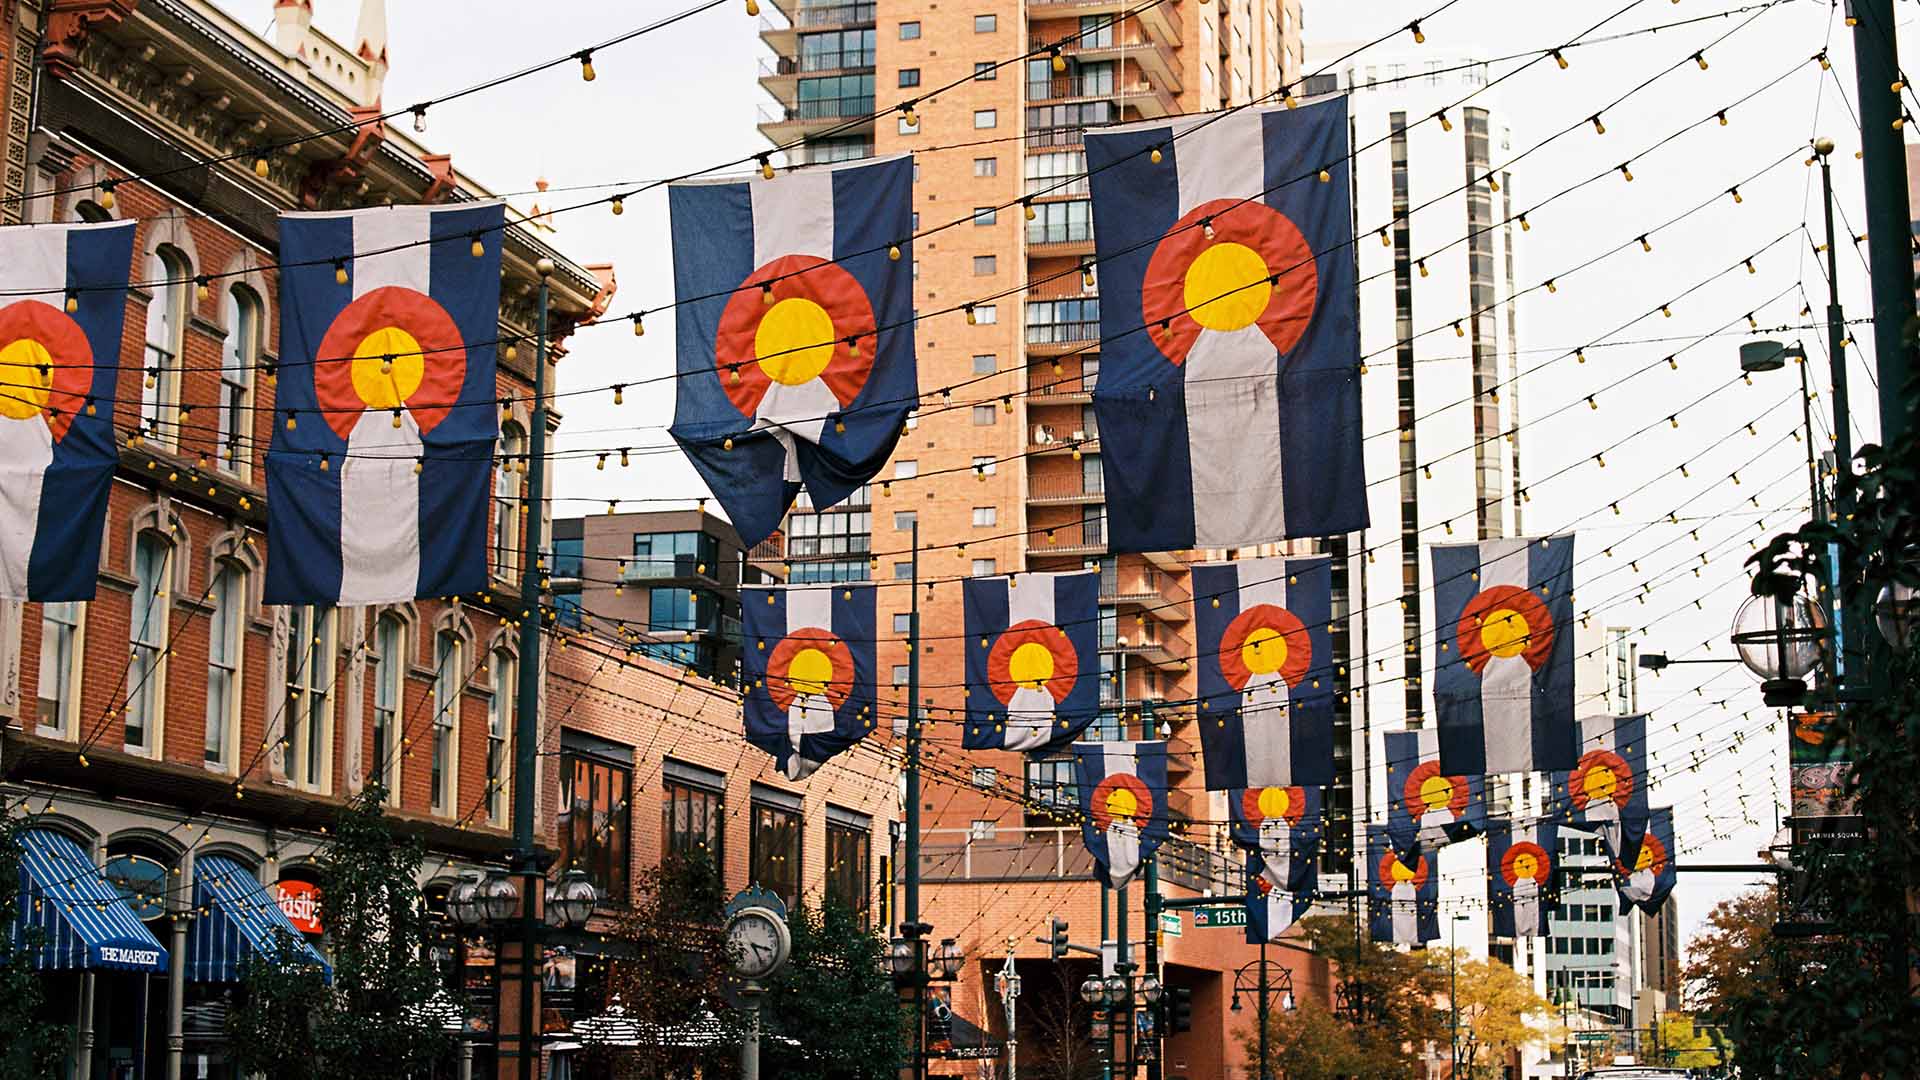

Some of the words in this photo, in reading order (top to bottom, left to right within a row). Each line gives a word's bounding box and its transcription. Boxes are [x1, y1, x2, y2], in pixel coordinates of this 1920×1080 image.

[1214, 910, 1247, 924] 15th
[100, 947, 119, 962] THE
[119, 949, 159, 965] MARKET
